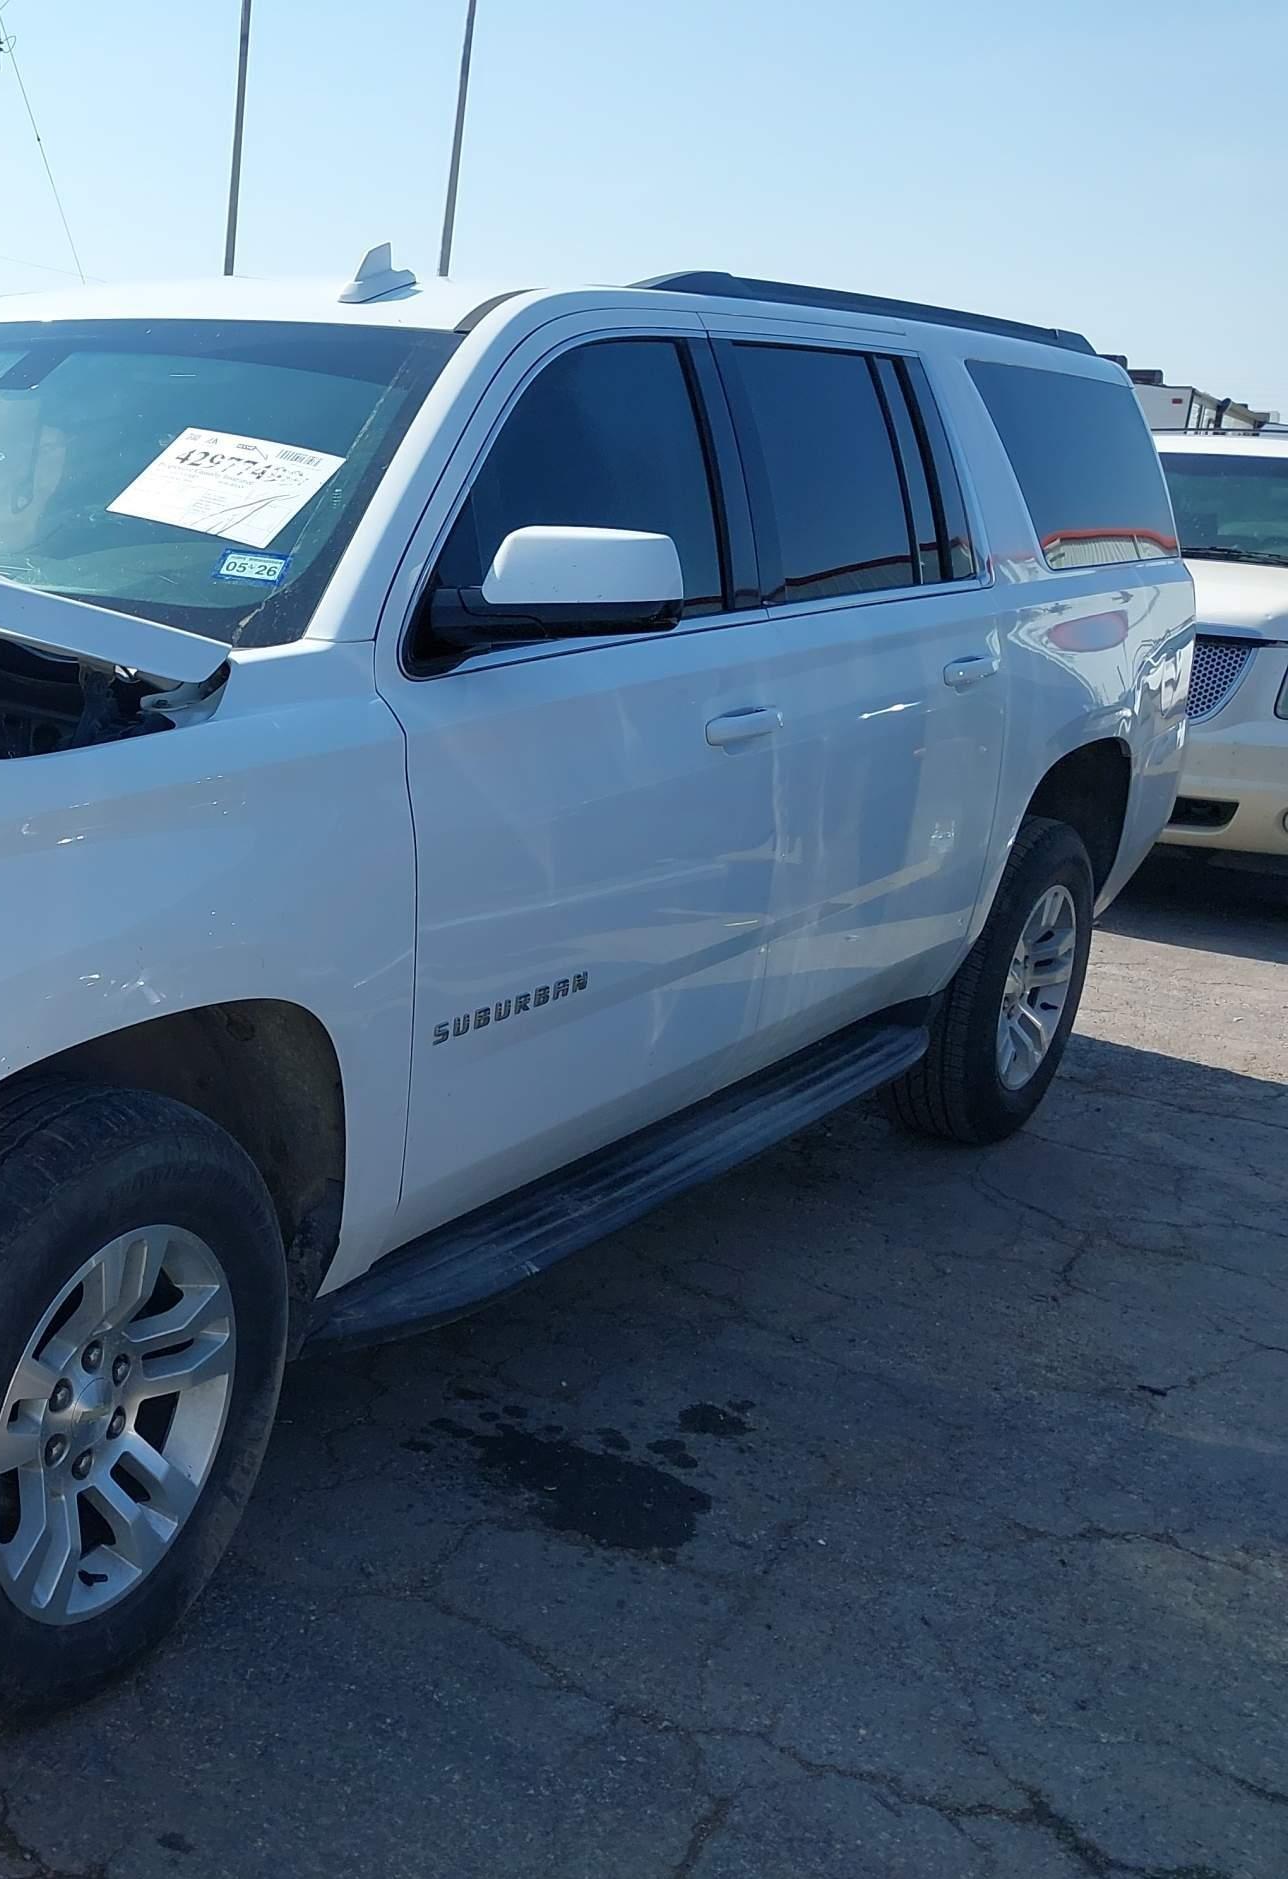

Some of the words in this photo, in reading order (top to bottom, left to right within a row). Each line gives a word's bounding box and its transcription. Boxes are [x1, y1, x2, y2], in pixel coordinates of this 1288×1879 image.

[226, 561, 249, 573] 05
[254, 564, 278, 577] 26
[432, 971, 589, 1046] SUBURBAN
